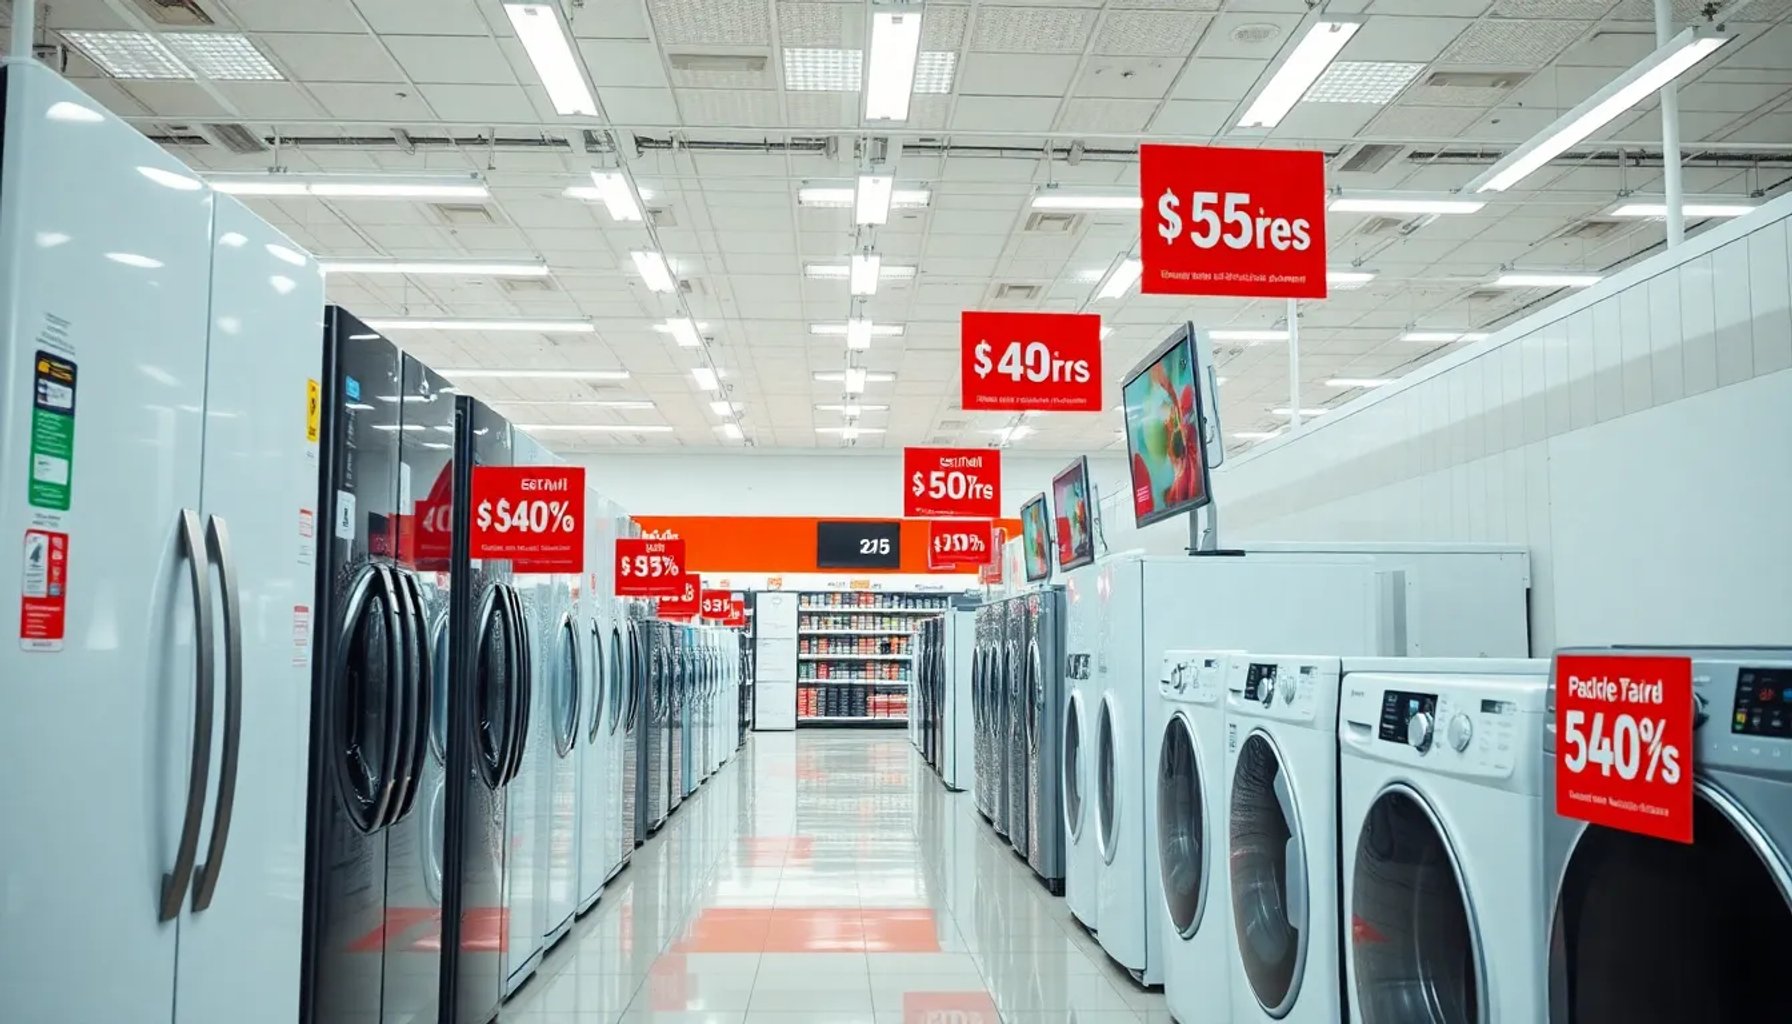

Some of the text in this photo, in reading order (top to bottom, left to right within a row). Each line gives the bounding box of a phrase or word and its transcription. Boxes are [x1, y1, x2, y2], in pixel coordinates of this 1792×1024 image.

[1157, 187, 1183, 246] $
[973, 339, 993, 380] $
[912, 471, 925, 497] $
